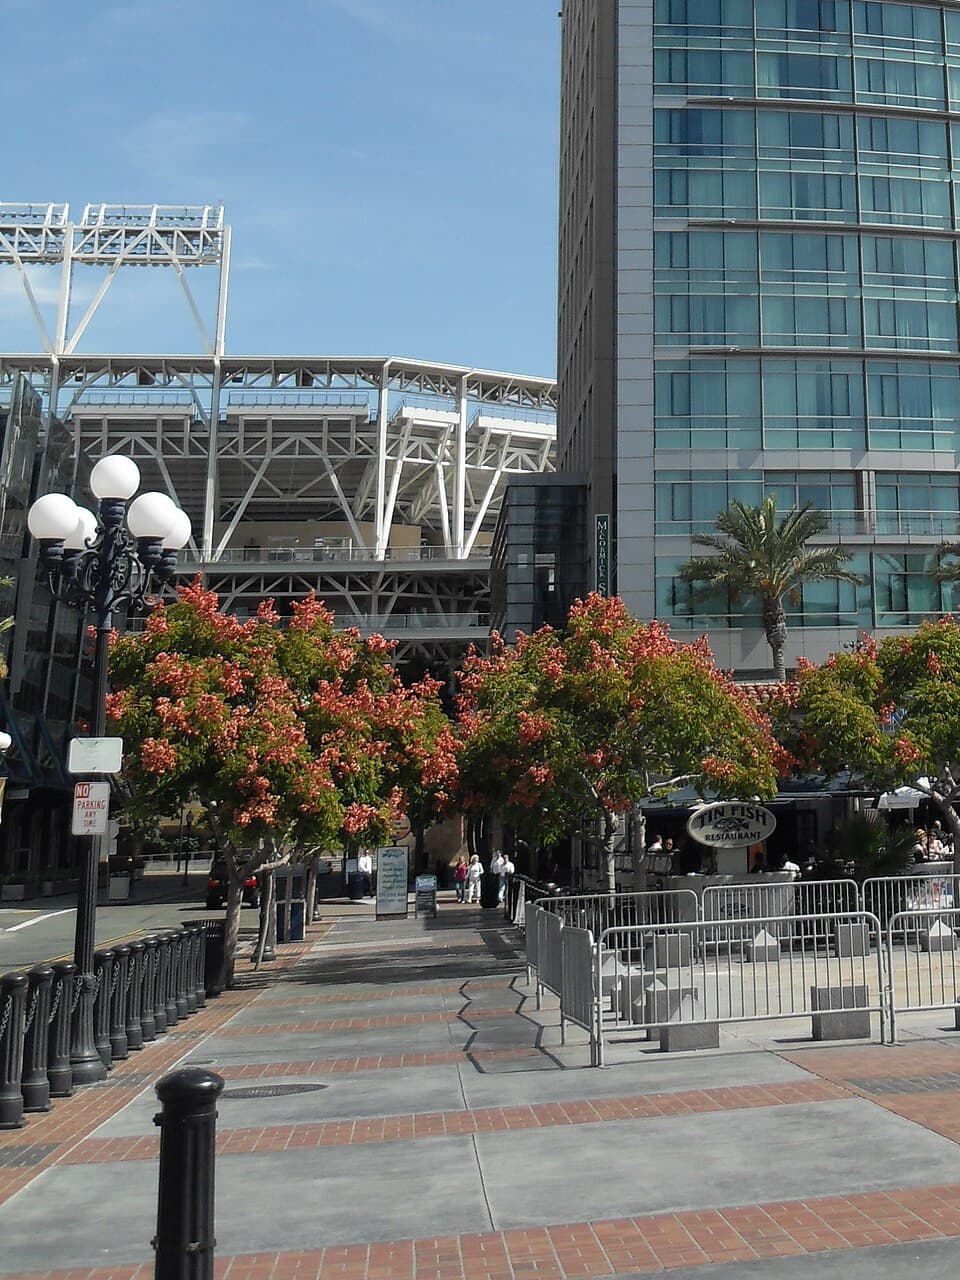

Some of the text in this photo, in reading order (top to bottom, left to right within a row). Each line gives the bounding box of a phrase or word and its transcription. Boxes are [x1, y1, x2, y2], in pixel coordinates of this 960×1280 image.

[76, 784, 89, 797] NO
[77, 800, 105, 809] PARKING
[699, 805, 767, 829] TIN FISH
[705, 832, 761, 841] RESTAURANT
